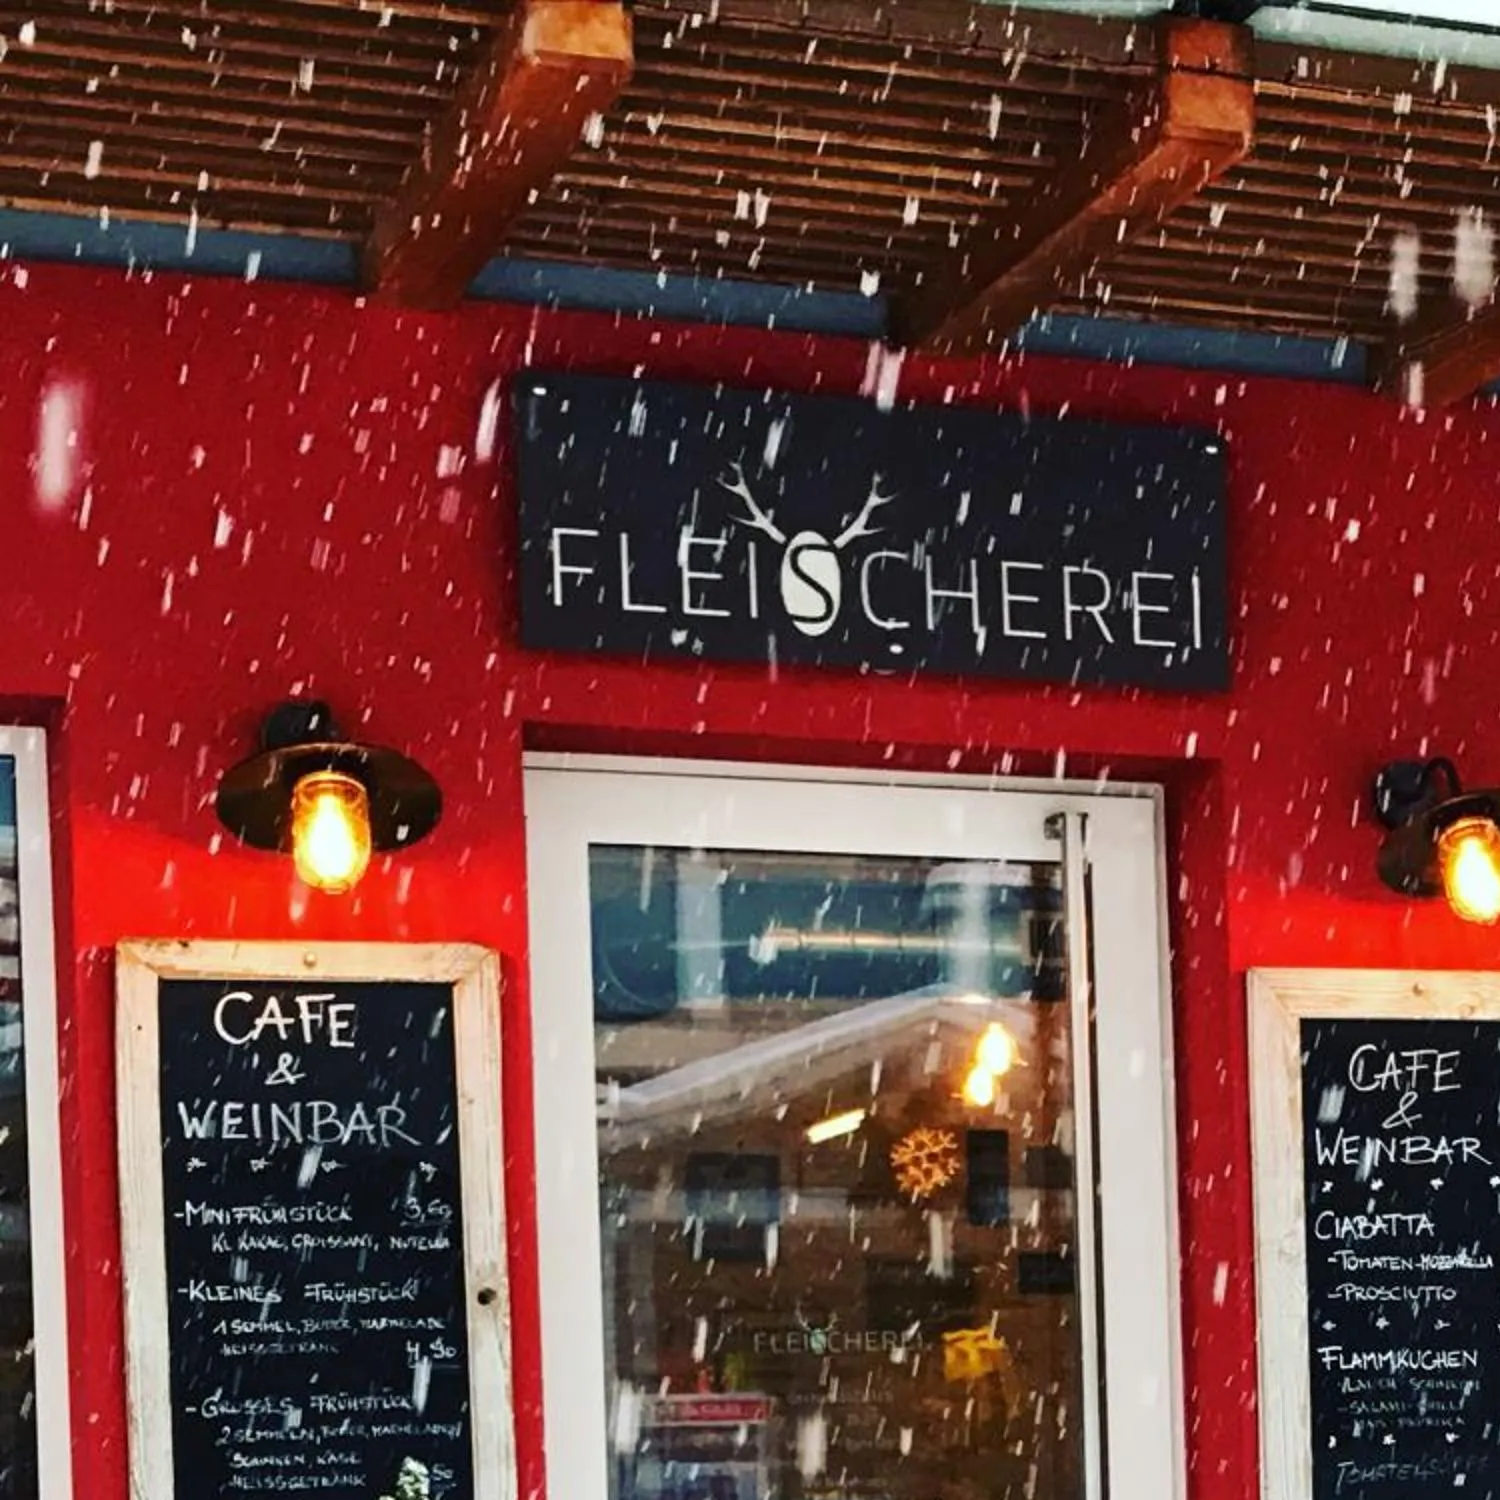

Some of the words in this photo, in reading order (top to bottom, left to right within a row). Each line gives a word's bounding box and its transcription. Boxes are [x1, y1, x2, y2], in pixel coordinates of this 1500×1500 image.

[550, 527, 1202, 650] FLEISCHEREI
[213, 992, 356, 1048] CAFE
[265, 1053, 305, 1085] &
[1349, 1044, 1461, 1093] CAFE
[178, 1101, 421, 1147] WEINBAR
[1382, 1091, 1423, 1130] &
[1315, 1128, 1492, 1166] WEINBAR
[1315, 1211, 1435, 1240] CIABATTA
[1317, 1346, 1478, 1373] FLAMMKUCHEN
